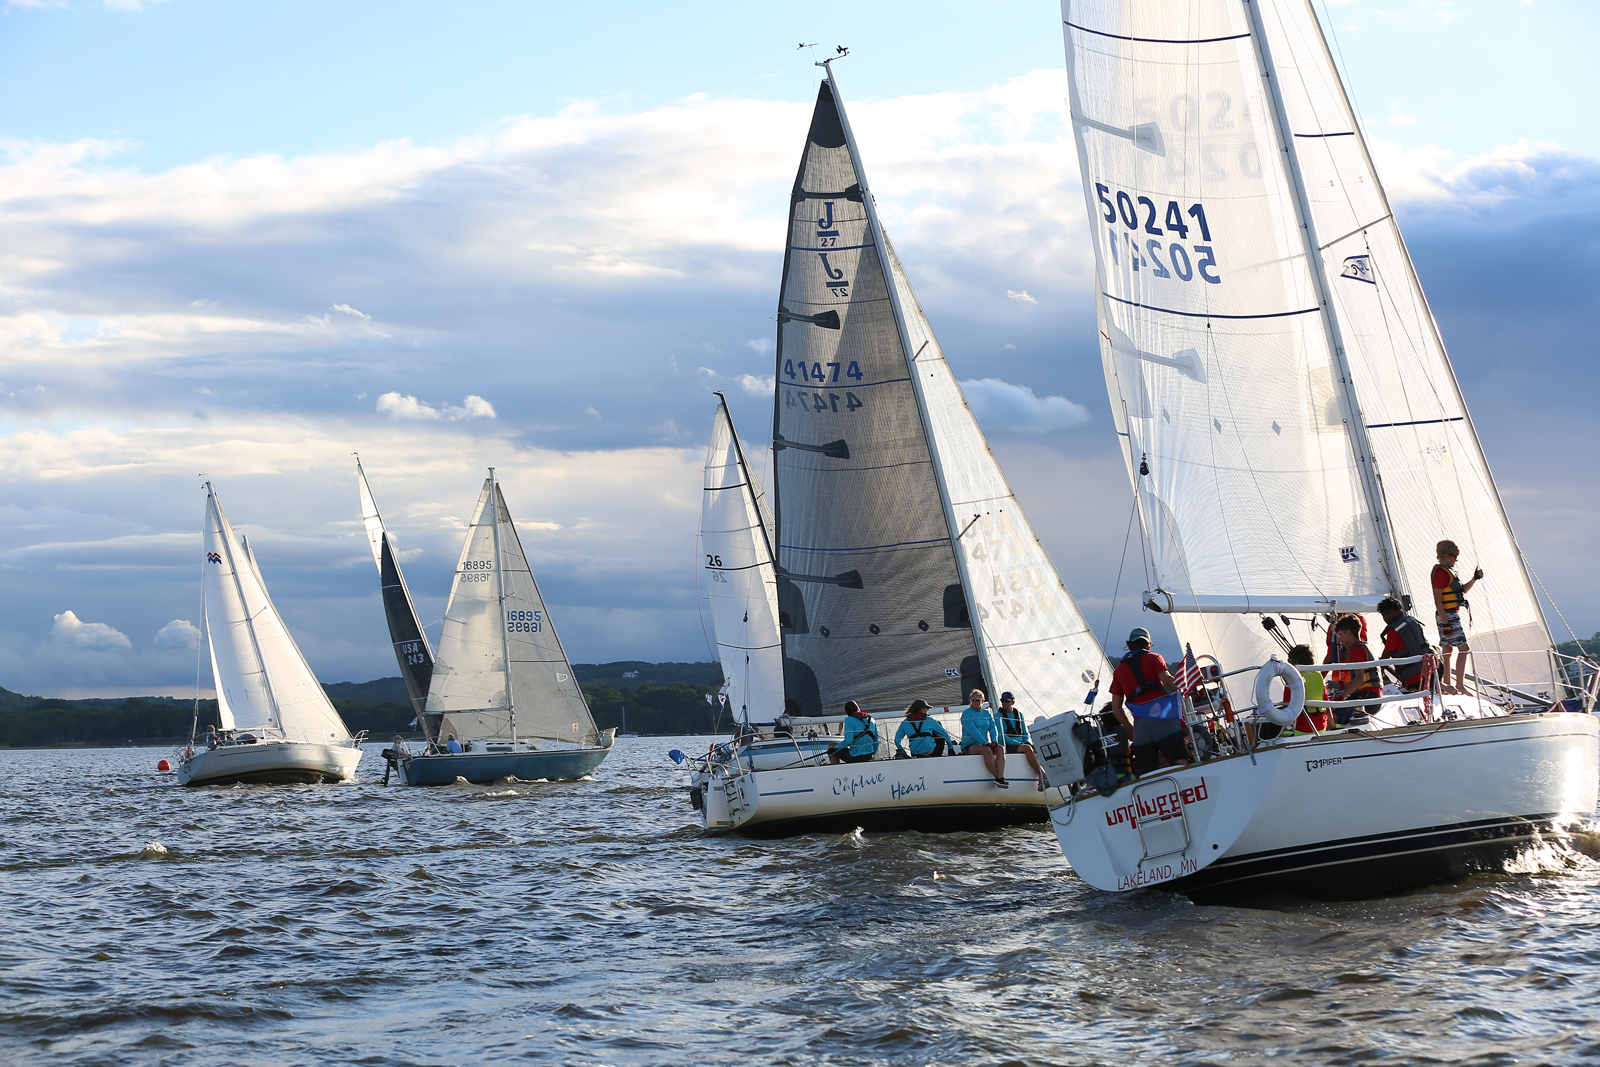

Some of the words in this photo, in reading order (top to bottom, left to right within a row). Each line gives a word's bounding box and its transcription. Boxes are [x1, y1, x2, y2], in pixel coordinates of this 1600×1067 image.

[818, 202, 834, 229] J
[1095, 182, 1212, 242] 50241
[821, 238, 836, 247] 27
[784, 359, 864, 382] 41474
[962, 512, 1015, 539] USA
[462, 560, 492, 570] 16895
[706, 554, 722, 567] 26
[507, 611, 541, 621] 16895
[402, 642, 419, 654] USA
[408, 653, 424, 665] 243
[833, 773, 886, 797] Captive
[891, 776, 926, 800] Heart
[1105, 776, 1208, 829] unplugged
[1117, 865, 1175, 891] LAKELAND,
[1180, 858, 1198, 873] MN
